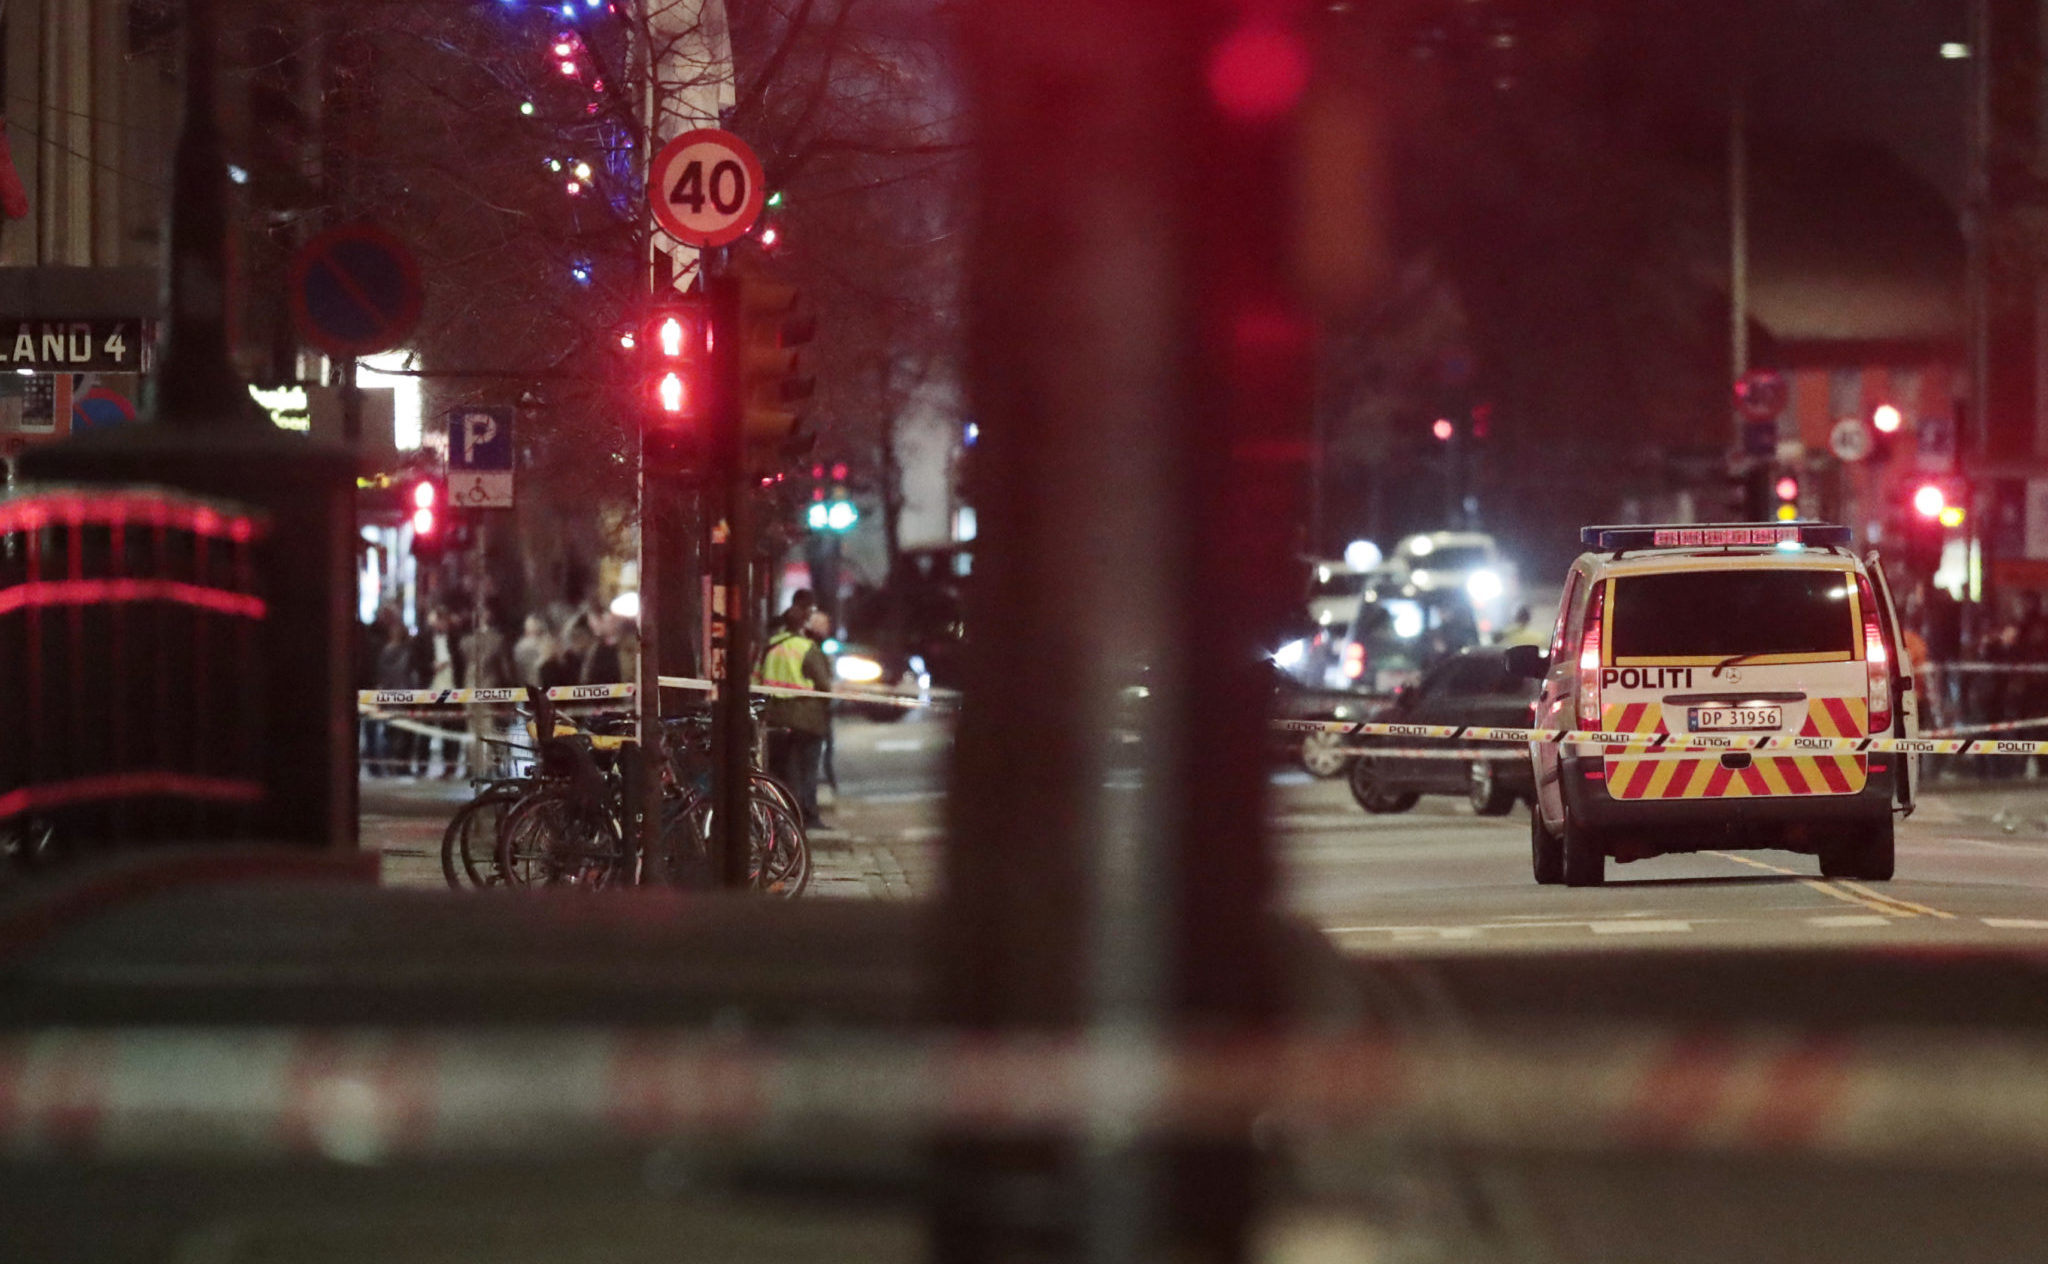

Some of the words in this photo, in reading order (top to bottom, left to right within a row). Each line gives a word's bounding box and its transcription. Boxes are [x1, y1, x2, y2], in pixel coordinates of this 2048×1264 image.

[669, 160, 745, 215] 40
[104, 323, 126, 362] 4
[464, 413, 497, 463] P
[1602, 668, 1692, 689] POLITI
[474, 689, 512, 699] POLITI
[573, 688, 610, 698] POLITI
[1702, 712, 1722, 725] DP
[1730, 711, 1776, 725] 31956
[1389, 725, 1427, 735] POLITI
[1490, 732, 1529, 741] POLITI
[1591, 733, 1630, 743] POLITI
[1692, 737, 1731, 747] POLITI
[1794, 738, 1832, 748] POLITI
[1895, 742, 1934, 752] POLITI
[1997, 742, 2036, 751] POLITI
